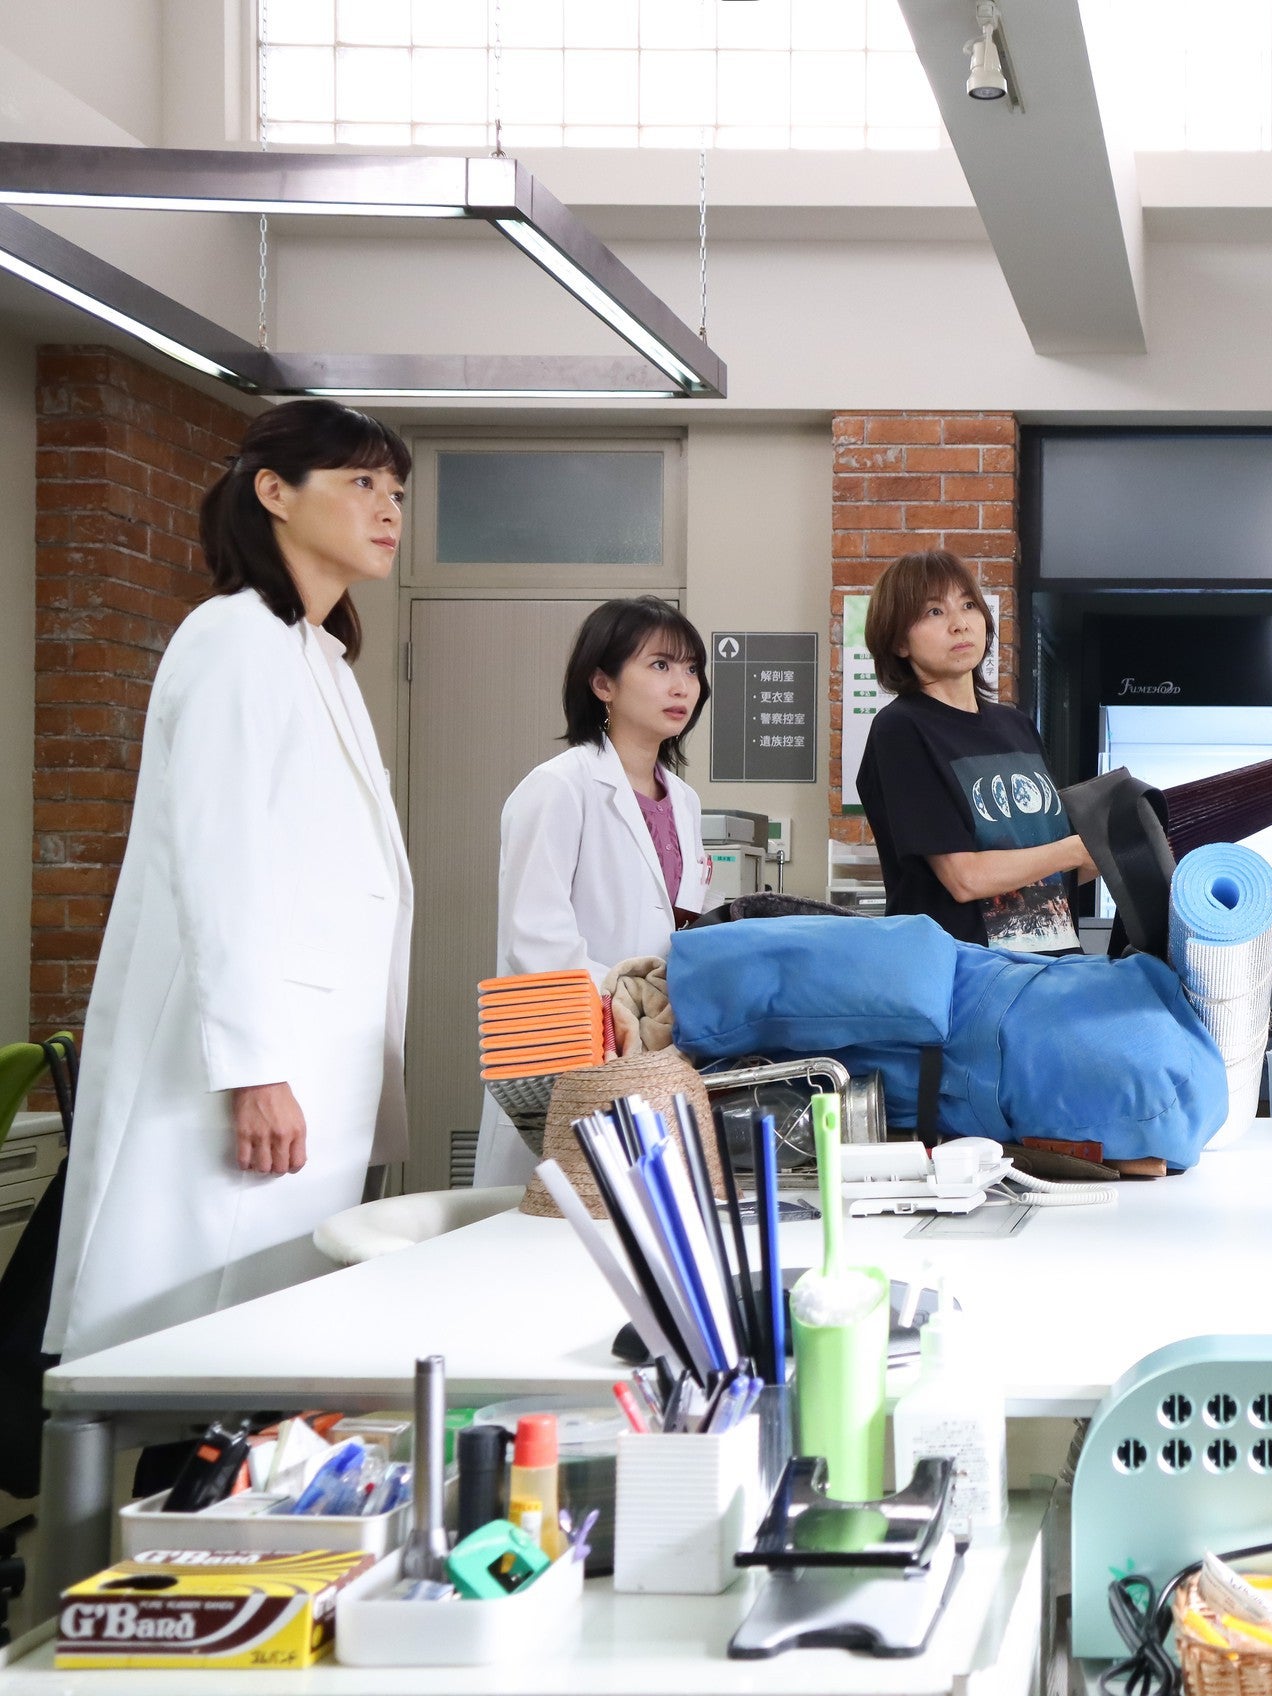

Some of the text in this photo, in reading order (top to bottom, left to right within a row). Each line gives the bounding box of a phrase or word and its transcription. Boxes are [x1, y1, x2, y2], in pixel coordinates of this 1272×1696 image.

[760, 670, 795, 682] 解剖室
[760, 691, 794, 703] 更衣室
[760, 713, 805, 725] 警察控室
[759, 735, 805, 747] 遺族控室
[60, 1600, 197, 1639] G'Band
